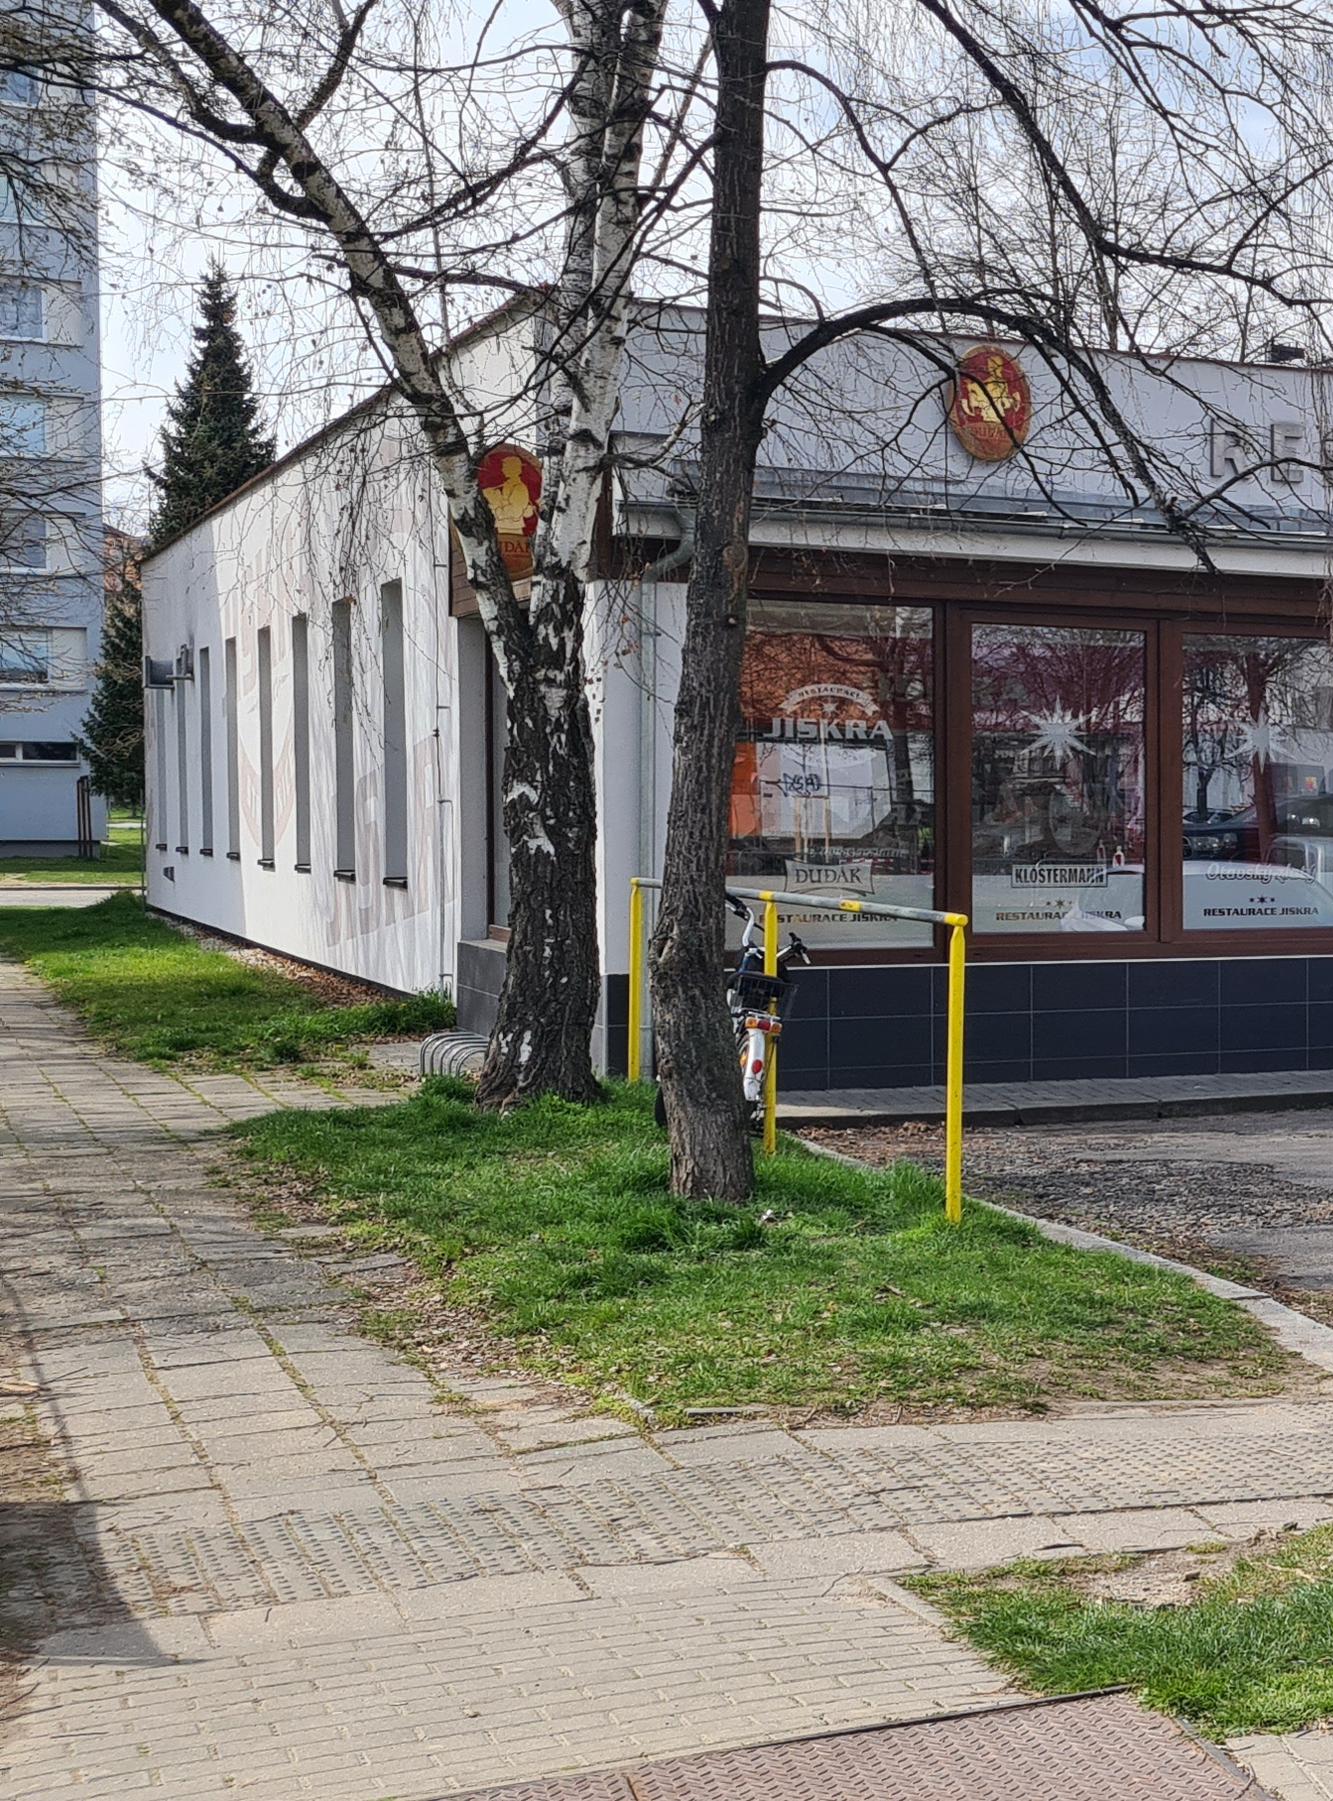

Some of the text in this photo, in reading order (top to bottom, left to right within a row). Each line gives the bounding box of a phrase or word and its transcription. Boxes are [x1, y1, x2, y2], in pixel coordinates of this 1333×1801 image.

[763, 717, 893, 740] JISKRA
[996, 910, 1072, 921] RESTAURA
[1203, 906, 1319, 917] RESTAURACE JISKRA
[758, 913, 847, 924] RSTAURACE
